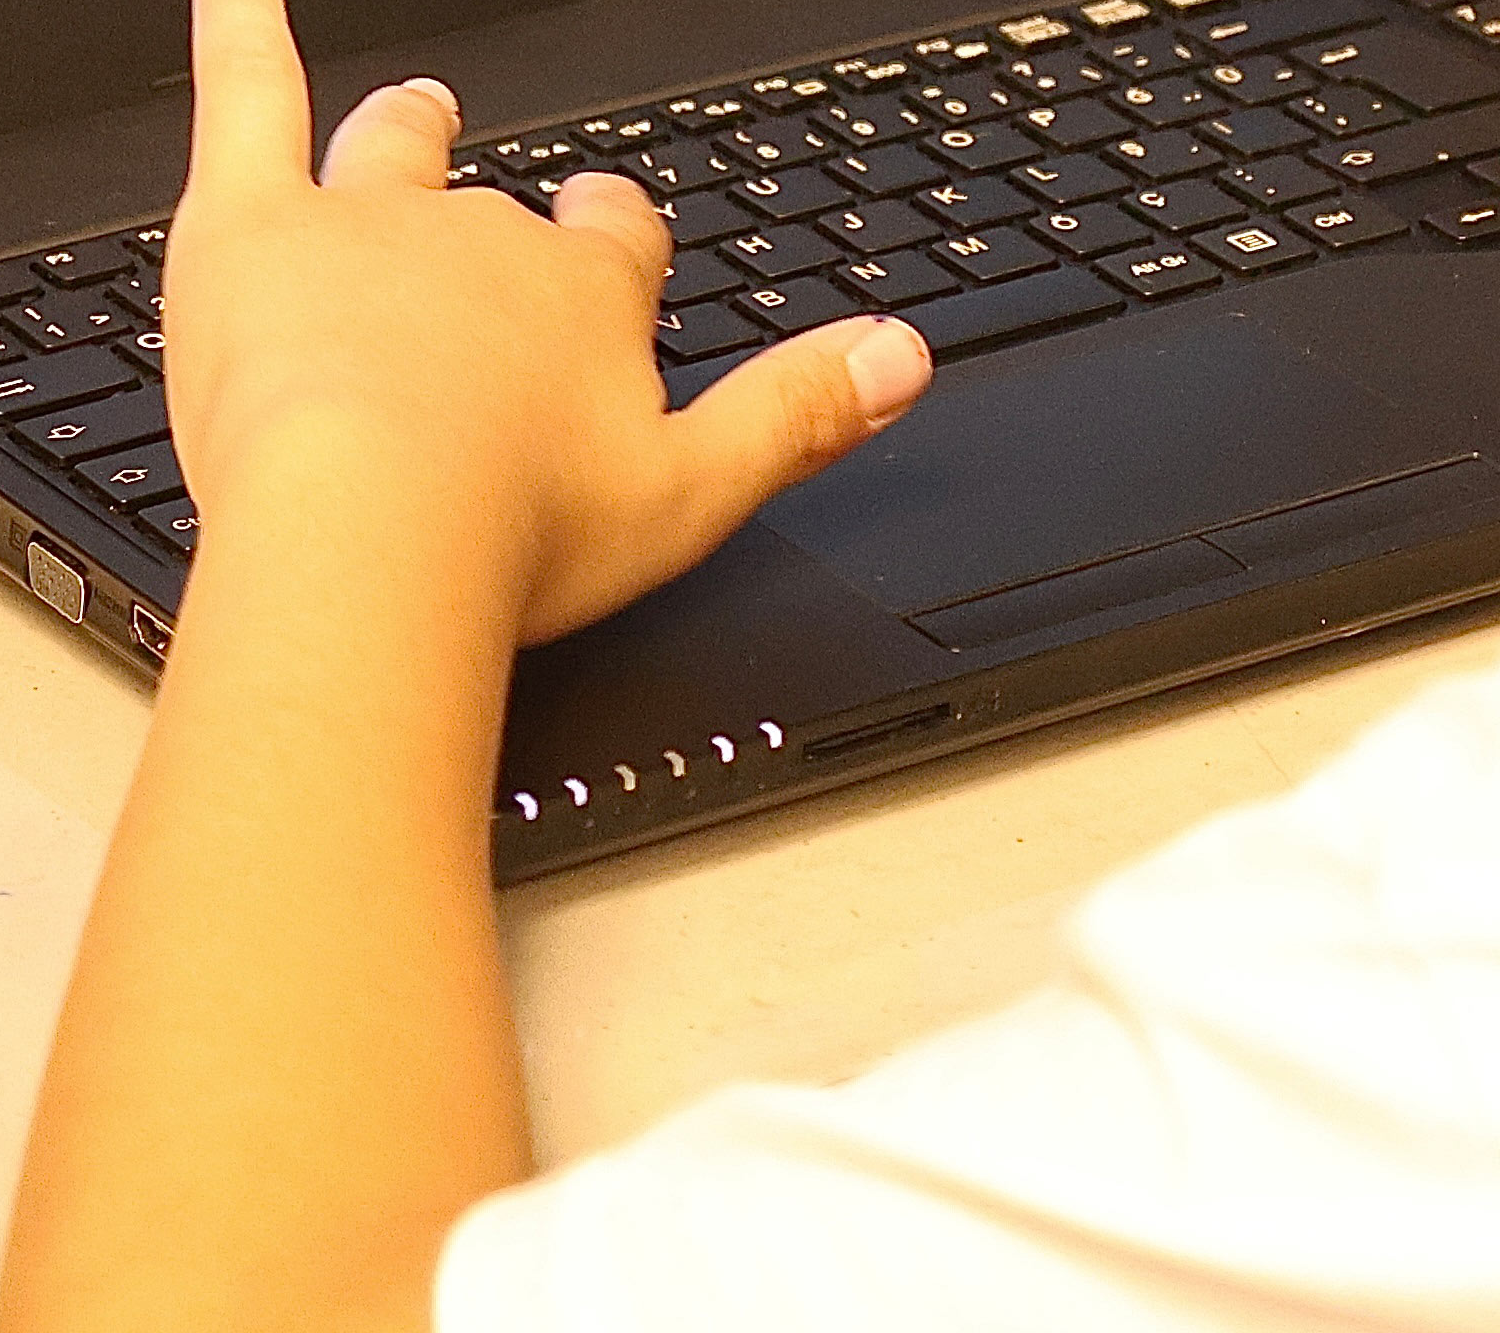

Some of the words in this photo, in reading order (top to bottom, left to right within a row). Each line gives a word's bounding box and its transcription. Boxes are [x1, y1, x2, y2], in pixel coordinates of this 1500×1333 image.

[930, 185, 969, 206] K
[1314, 210, 1355, 230] Ctrl
[735, 234, 774, 255] H
[948, 235, 990, 257] M
[850, 261, 889, 282] N
[1130, 259, 1161, 278] Alt
[751, 289, 788, 310] B
